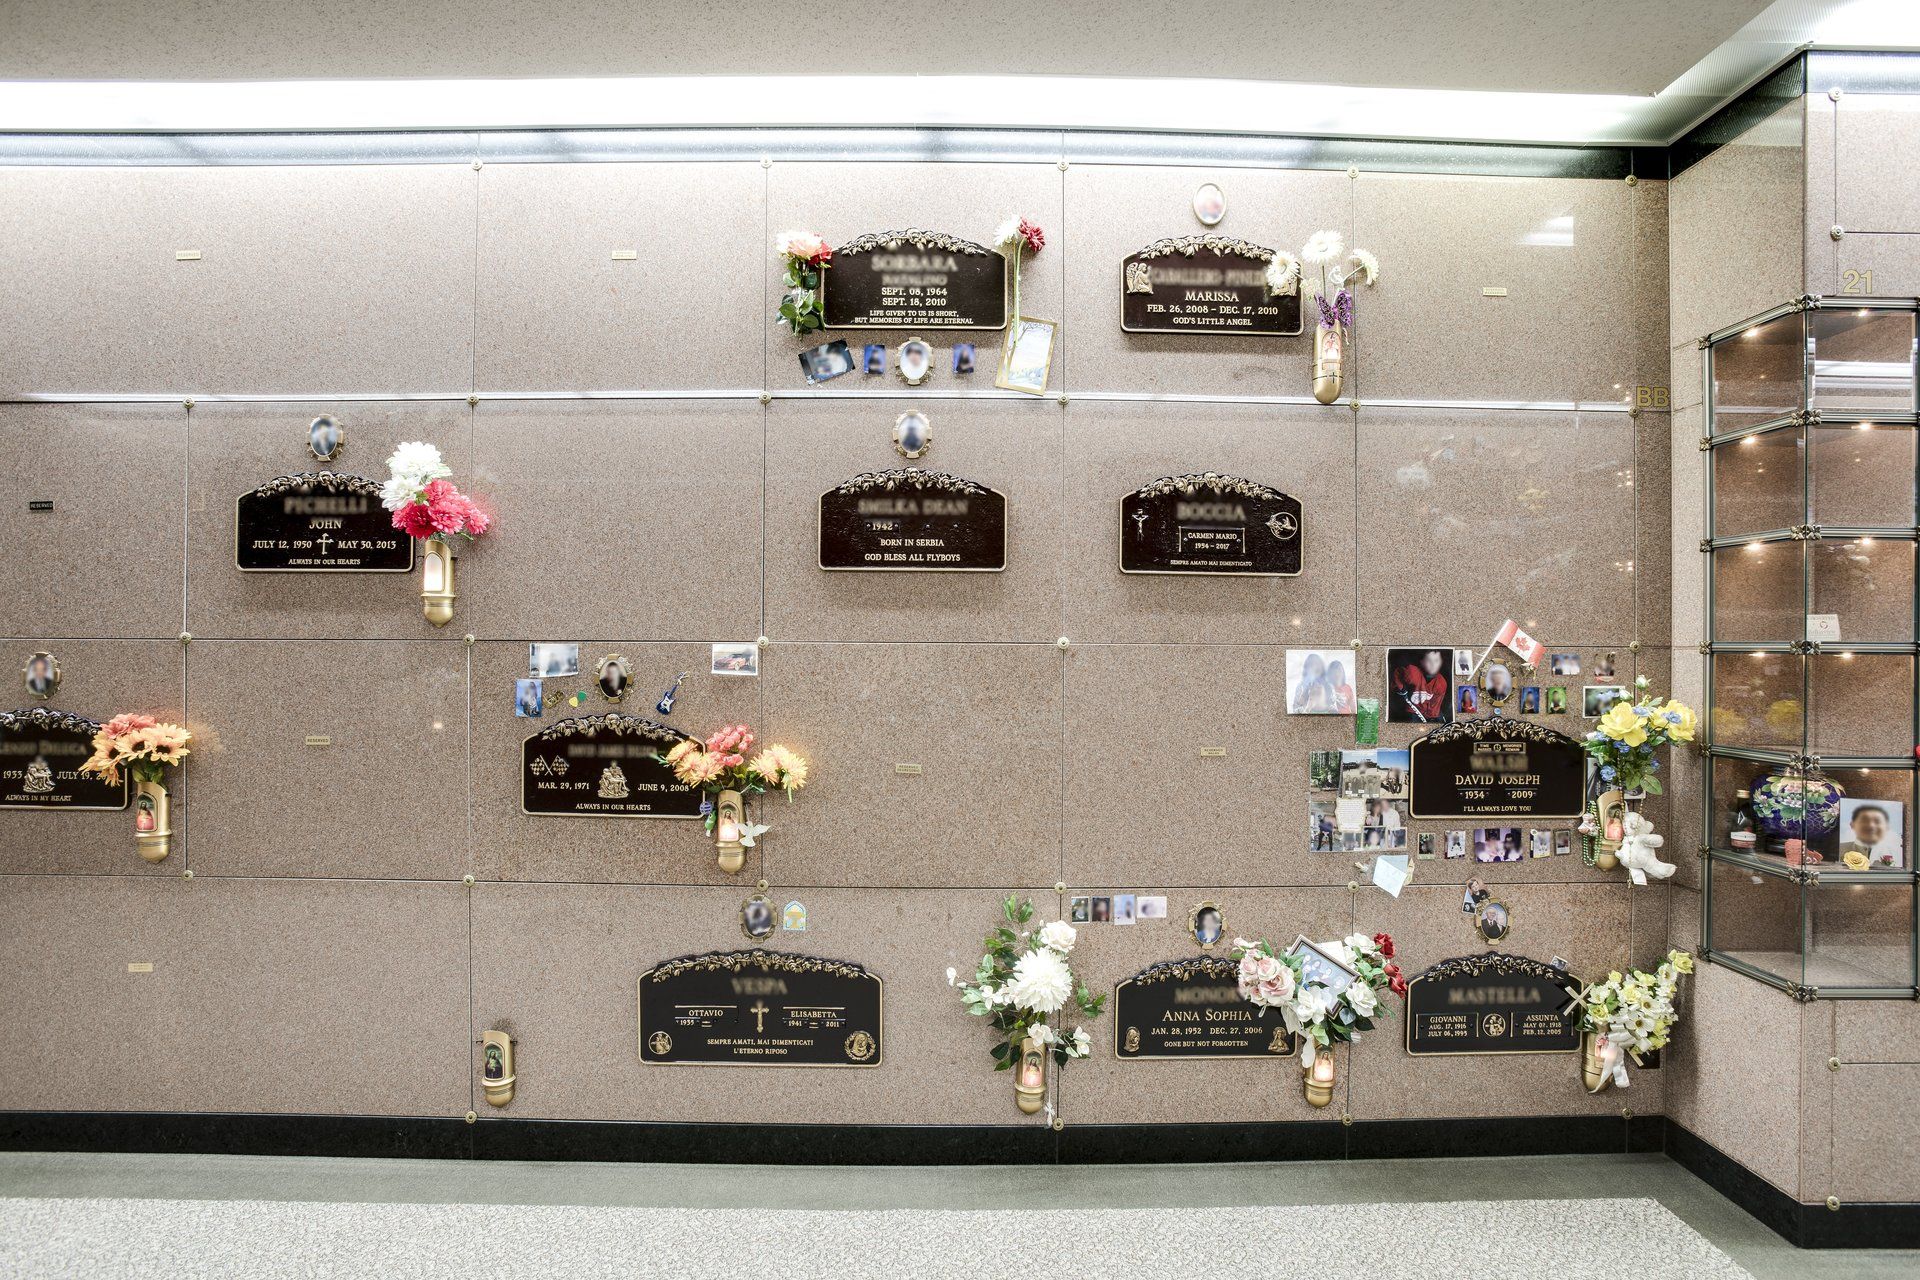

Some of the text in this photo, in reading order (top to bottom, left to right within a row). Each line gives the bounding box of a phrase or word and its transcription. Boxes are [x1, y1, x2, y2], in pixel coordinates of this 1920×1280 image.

[1843, 269, 1872, 294] 21
[882, 287, 947, 297] SEPT. 08, 1964
[1185, 292, 1239, 302] MARISSA
[882, 298, 946, 307] SEPT. 18, 2010
[1147, 305, 1166, 313] FEB.
[1170, 305, 1183, 314] 26,
[1186, 305, 1208, 313] 2008
[1219, 306, 1240, 314] DEC.
[1243, 307, 1255, 315] 17,
[1258, 307, 1278, 315] 2010
[1636, 386, 1669, 407] BB
[309, 520, 342, 529] JOHN
[872, 523, 893, 531] 1942
[1215, 532, 1237, 540] MARIO
[252, 540, 275, 549] JULY
[293, 540, 312, 549] 1950
[338, 541, 358, 549] MAY
[376, 541, 396, 549] 2013
[916, 539, 944, 547] SERBIA
[57, 771, 78, 780] JULY
[1455, 775, 1540, 785] DAVID JOSEPH
[574, 782, 589, 790] 1971
[638, 784, 658, 792] JUNE
[670, 784, 689, 792] 2008
[1511, 791, 1533, 799] 2009
[689, 1009, 723, 1017] OTTAVIO
[790, 1010, 837, 1018] ELISABETTA
[1430, 1015, 1467, 1023] GIOVANNI
[1151, 1028, 1168, 1036] JAN.
[1171, 1028, 1182, 1036] 28,
[1185, 1027, 1201, 1035] 1952
[1210, 1027, 1227, 1035] DEC.
[732, 1038, 756, 1047] AMATI,
[772, 1039, 814, 1047] DIMENTICATI
[1164, 1040, 1182, 1048] GONE
